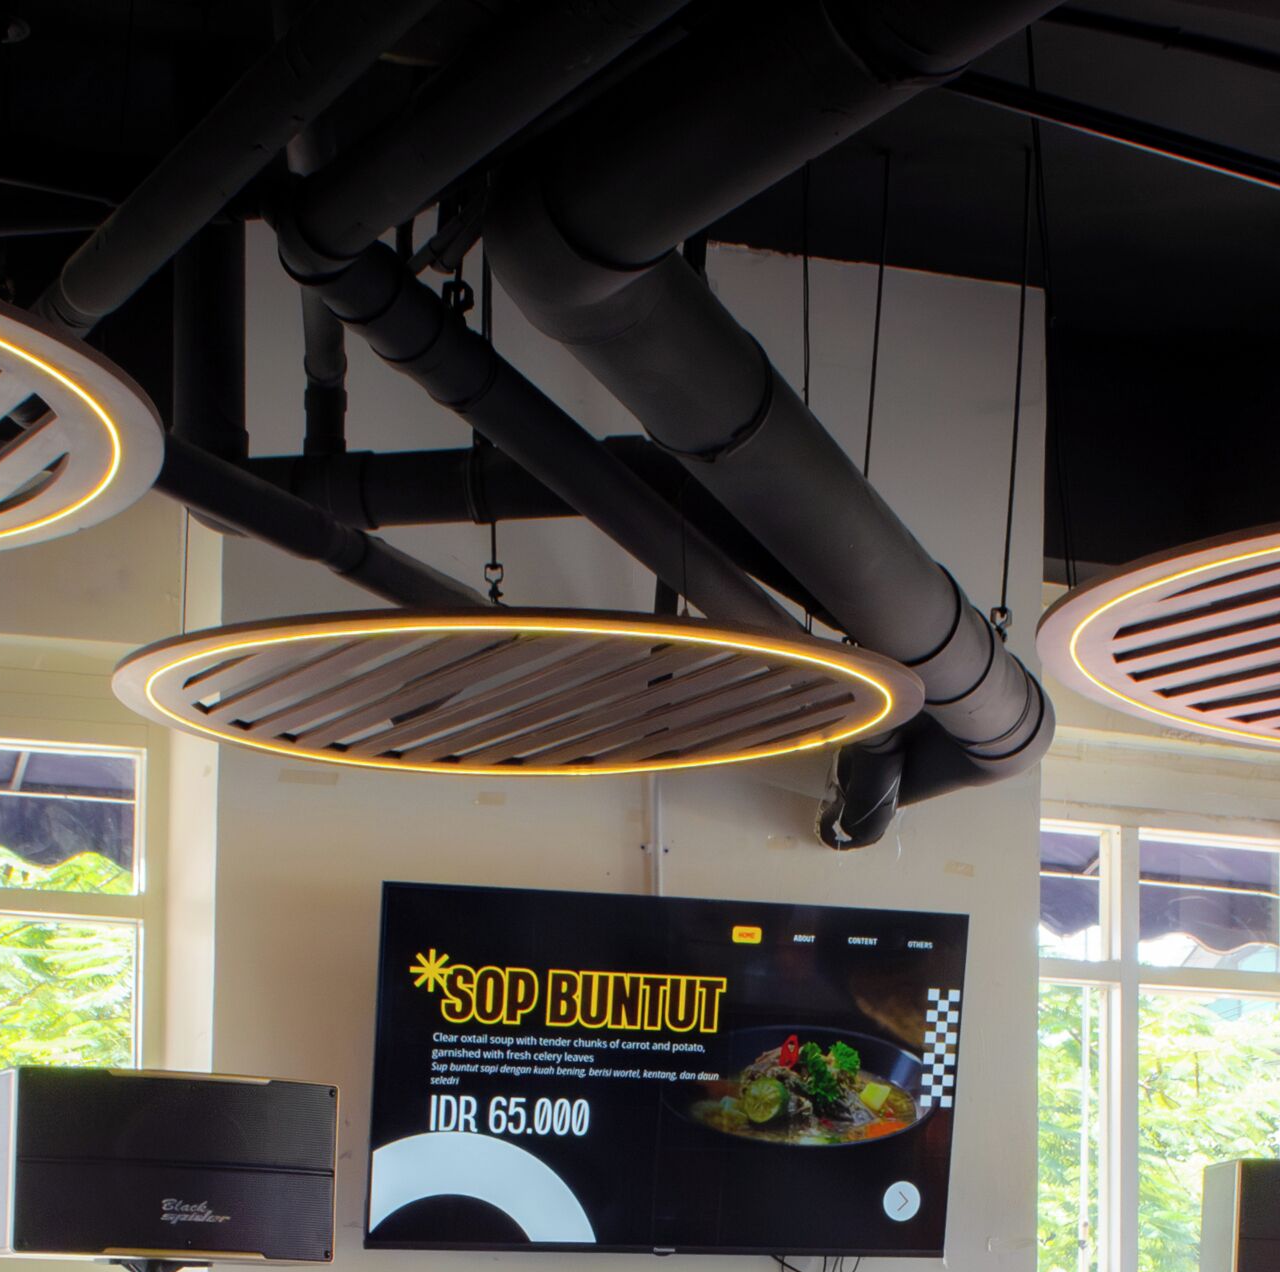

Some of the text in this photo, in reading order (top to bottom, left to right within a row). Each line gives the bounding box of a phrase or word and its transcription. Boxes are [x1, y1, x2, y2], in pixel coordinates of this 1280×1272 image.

[793, 934, 815, 943] ABOUT
[848, 937, 878, 946] CONTENT
[907, 941, 933, 949] OTHERS
[440, 964, 727, 1033] SOP BUNTUT
[432, 1032, 706, 1054] Clear oxtail soup with tender chunks of carrot and potato,
[431, 1048, 594, 1064] garnished with fresh celery leaves
[430, 1075, 459, 1085] seledri
[431, 1062, 720, 1082] Sup buntut sapi dengan kuah bening, berisi wortel, kentang, dan daun
[429, 1095, 590, 1136] IDR 65.000
